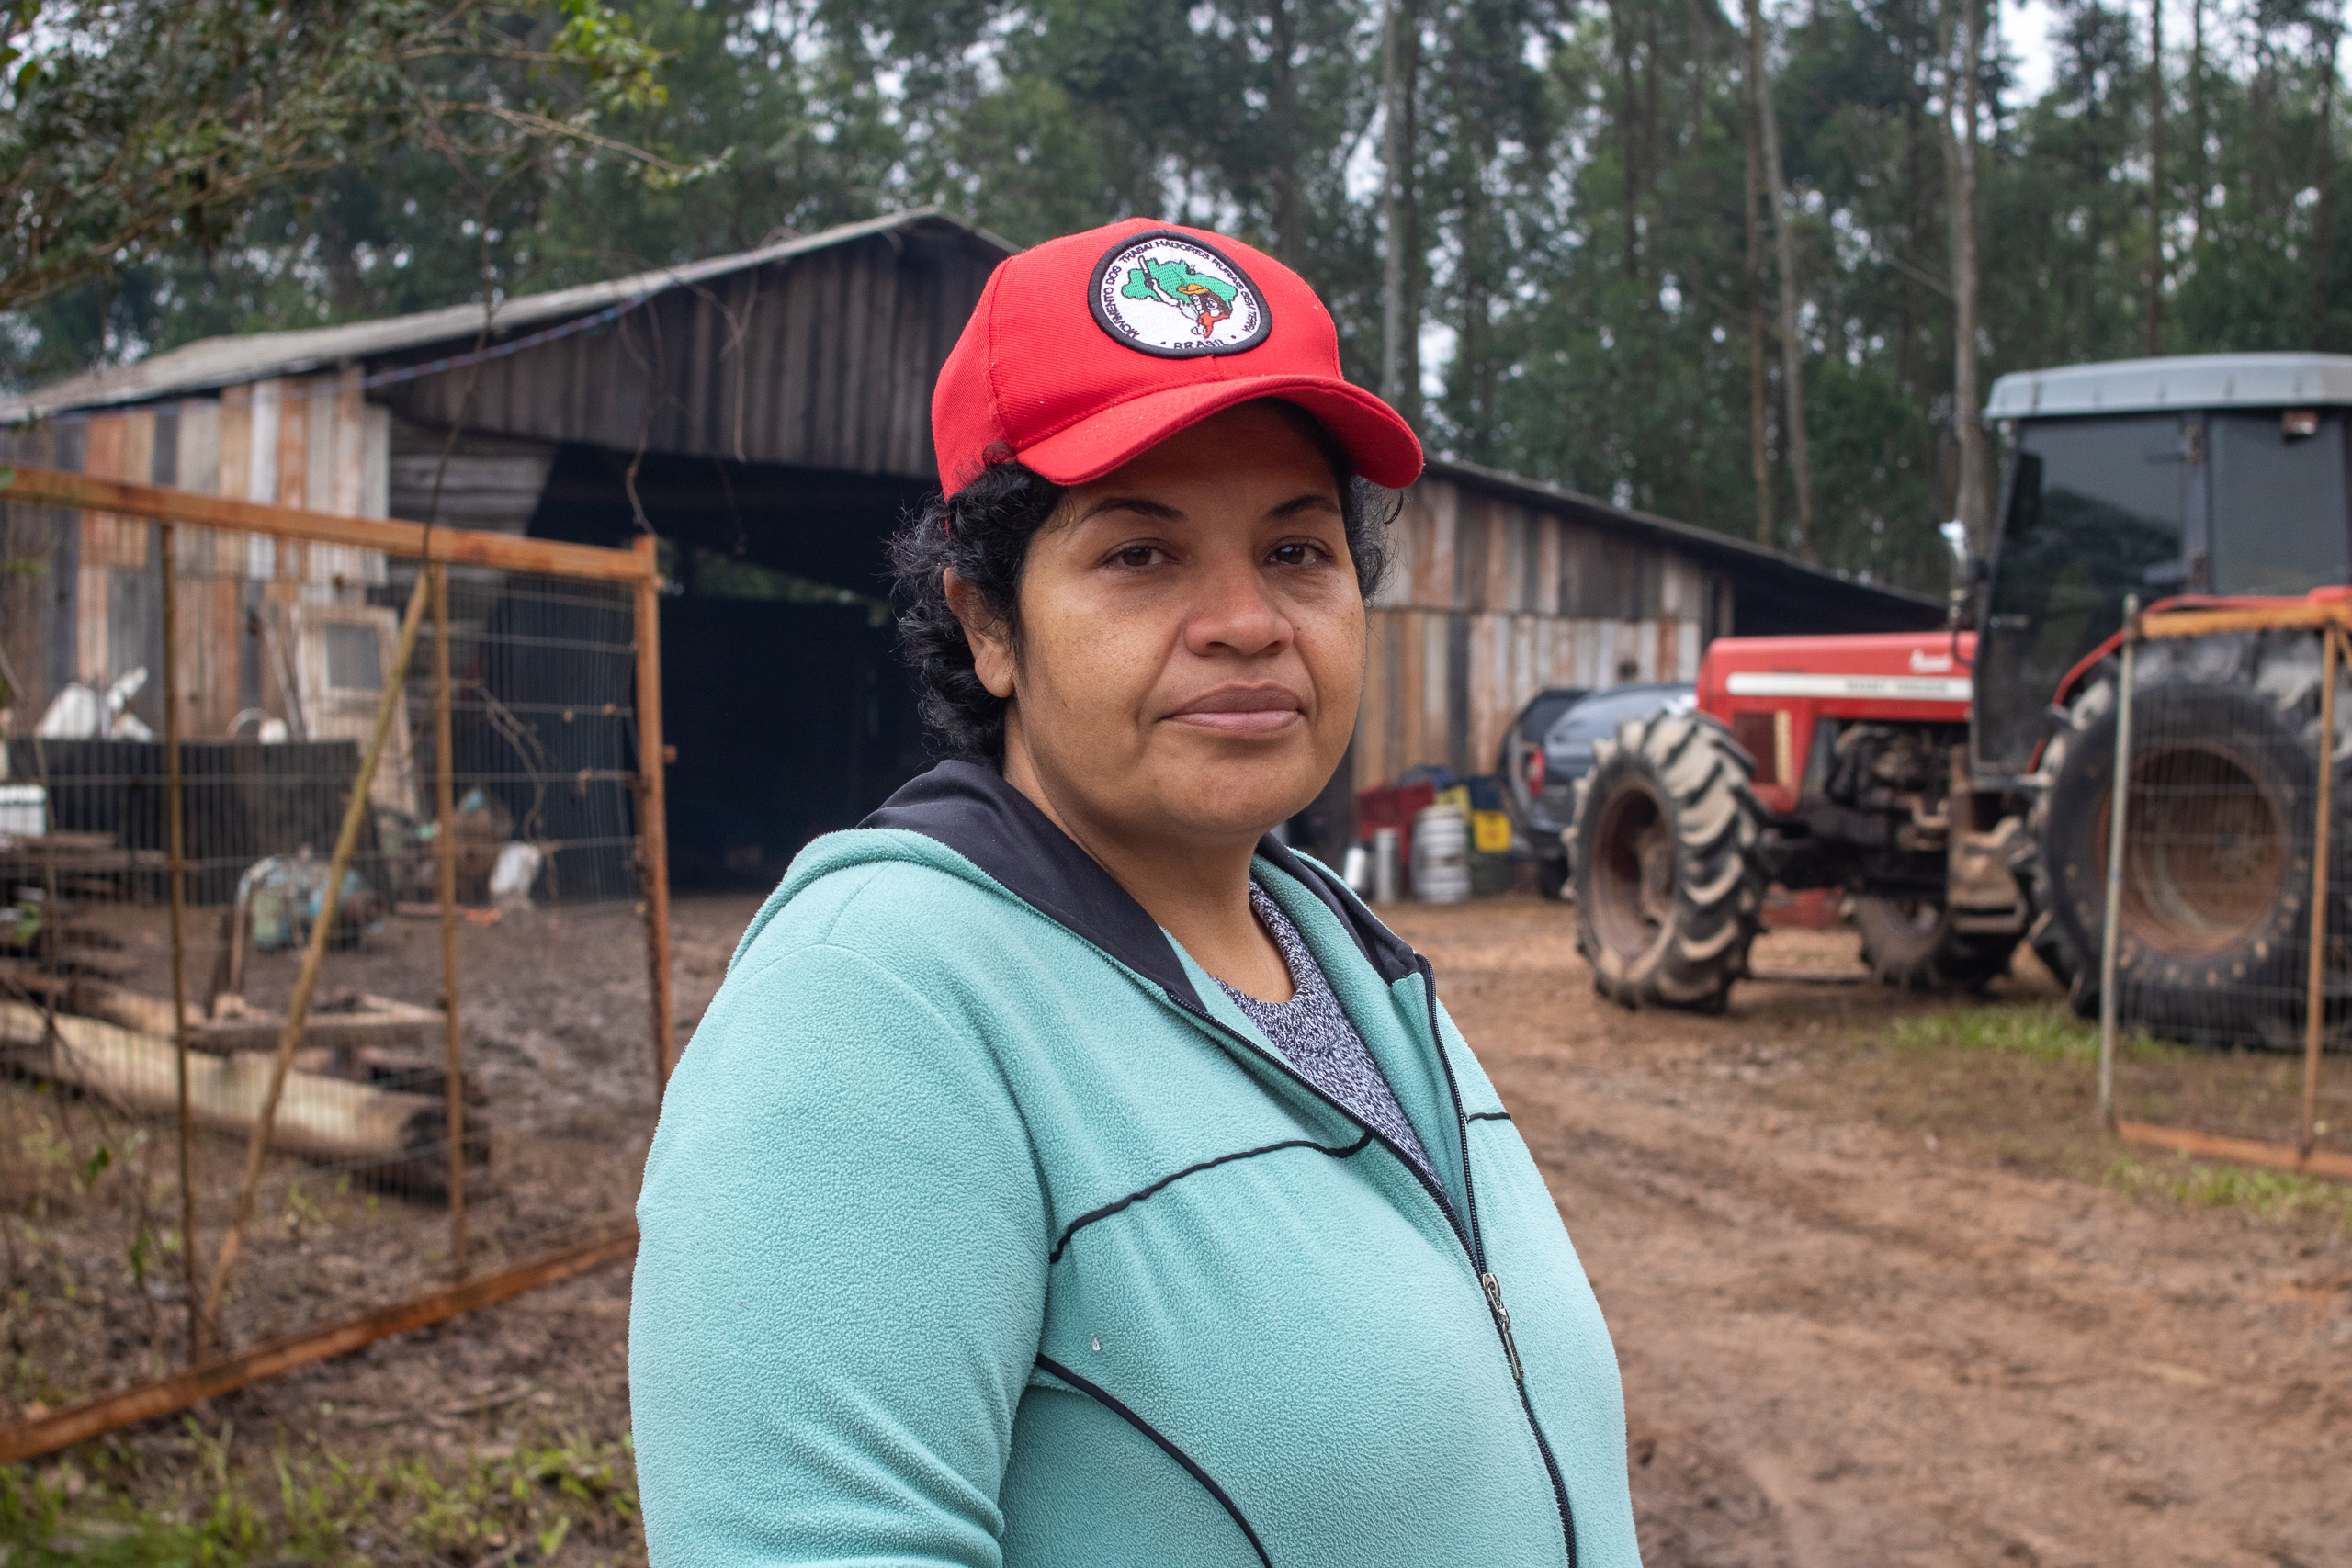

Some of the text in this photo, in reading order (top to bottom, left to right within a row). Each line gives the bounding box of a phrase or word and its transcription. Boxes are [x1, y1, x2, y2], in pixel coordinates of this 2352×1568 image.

[1105, 265, 1122, 285] DOS
[1242, 311, 1257, 333] TERRA
[1174, 339, 1229, 349] BRASIL
